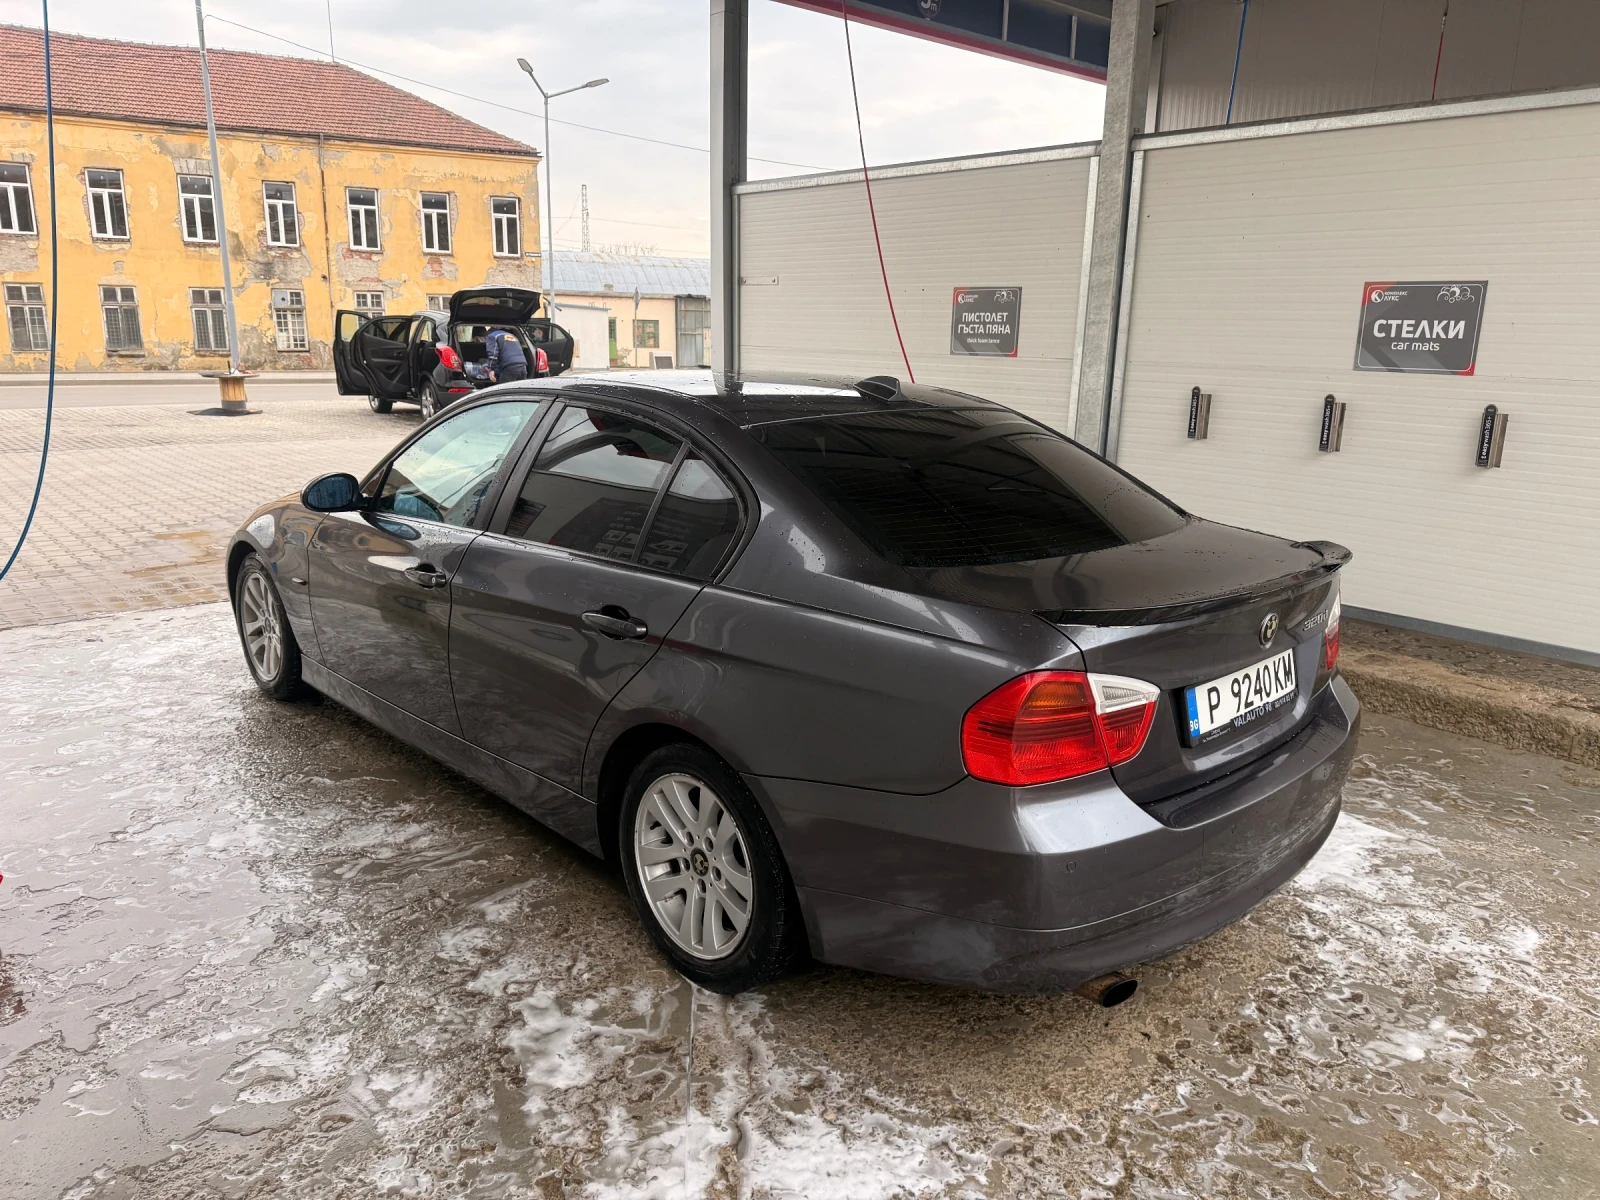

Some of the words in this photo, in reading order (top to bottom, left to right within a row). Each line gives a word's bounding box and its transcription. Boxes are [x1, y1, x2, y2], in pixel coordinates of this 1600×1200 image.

[962, 312, 1008, 322] ПИСТОЛЕТ
[958, 324, 984, 334] ГЪСТА
[986, 324, 1010, 334] ПЯНА
[1373, 319, 1466, 339] СТЕЛКИ
[1391, 342, 1410, 350] car
[1411, 341, 1440, 351] mats
[1207, 686, 1220, 724] P
[1233, 706, 1265, 728] VALAUTO
